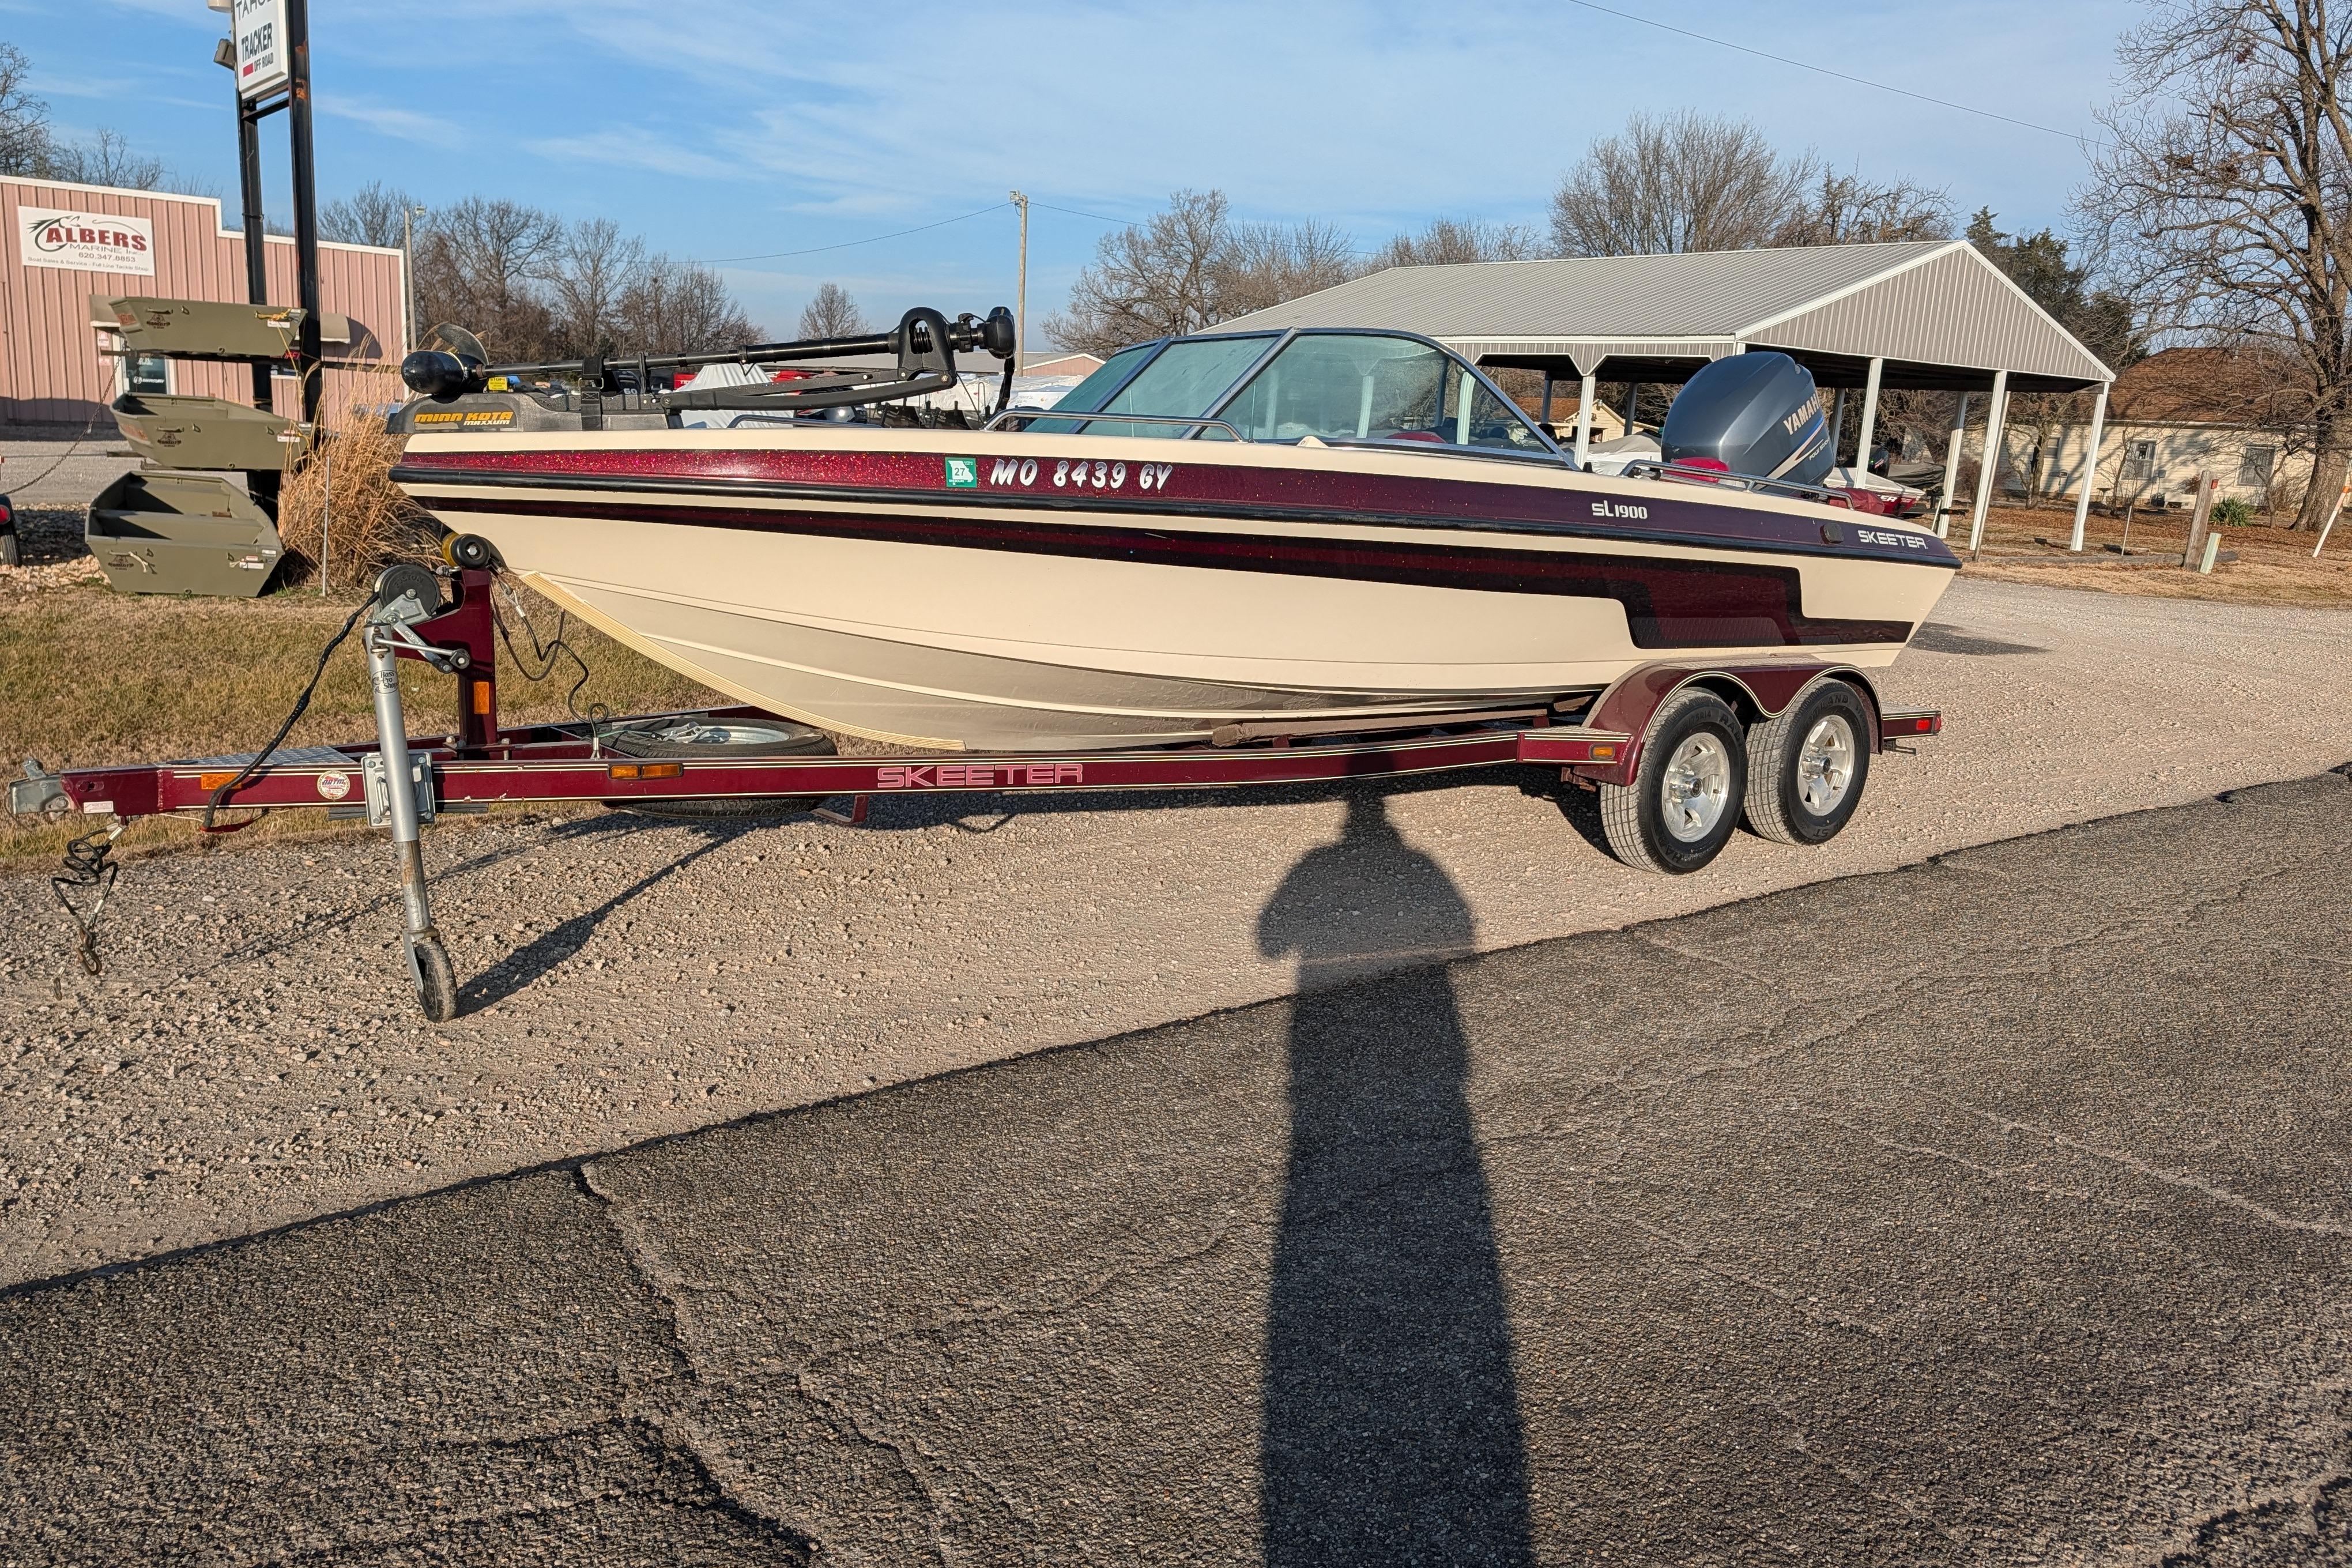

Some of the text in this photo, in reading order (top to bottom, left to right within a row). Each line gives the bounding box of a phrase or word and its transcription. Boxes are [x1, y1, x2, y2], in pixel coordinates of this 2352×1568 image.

[236, 0, 272, 21] TAH
[241, 22, 273, 63] TRACKER
[254, 52, 274, 72] OFF ROAD
[46, 227, 147, 251] ALBERS
[69, 243, 122, 254] MARINE
[414, 412, 514, 423] MINN KOTA
[1782, 393, 1820, 436] YAMAH
[954, 467, 966, 476] 27
[990, 458, 1173, 491] MO 8439 GY
[1857, 529, 1928, 549] SKEETER
[877, 763, 1083, 789] SKEETER
